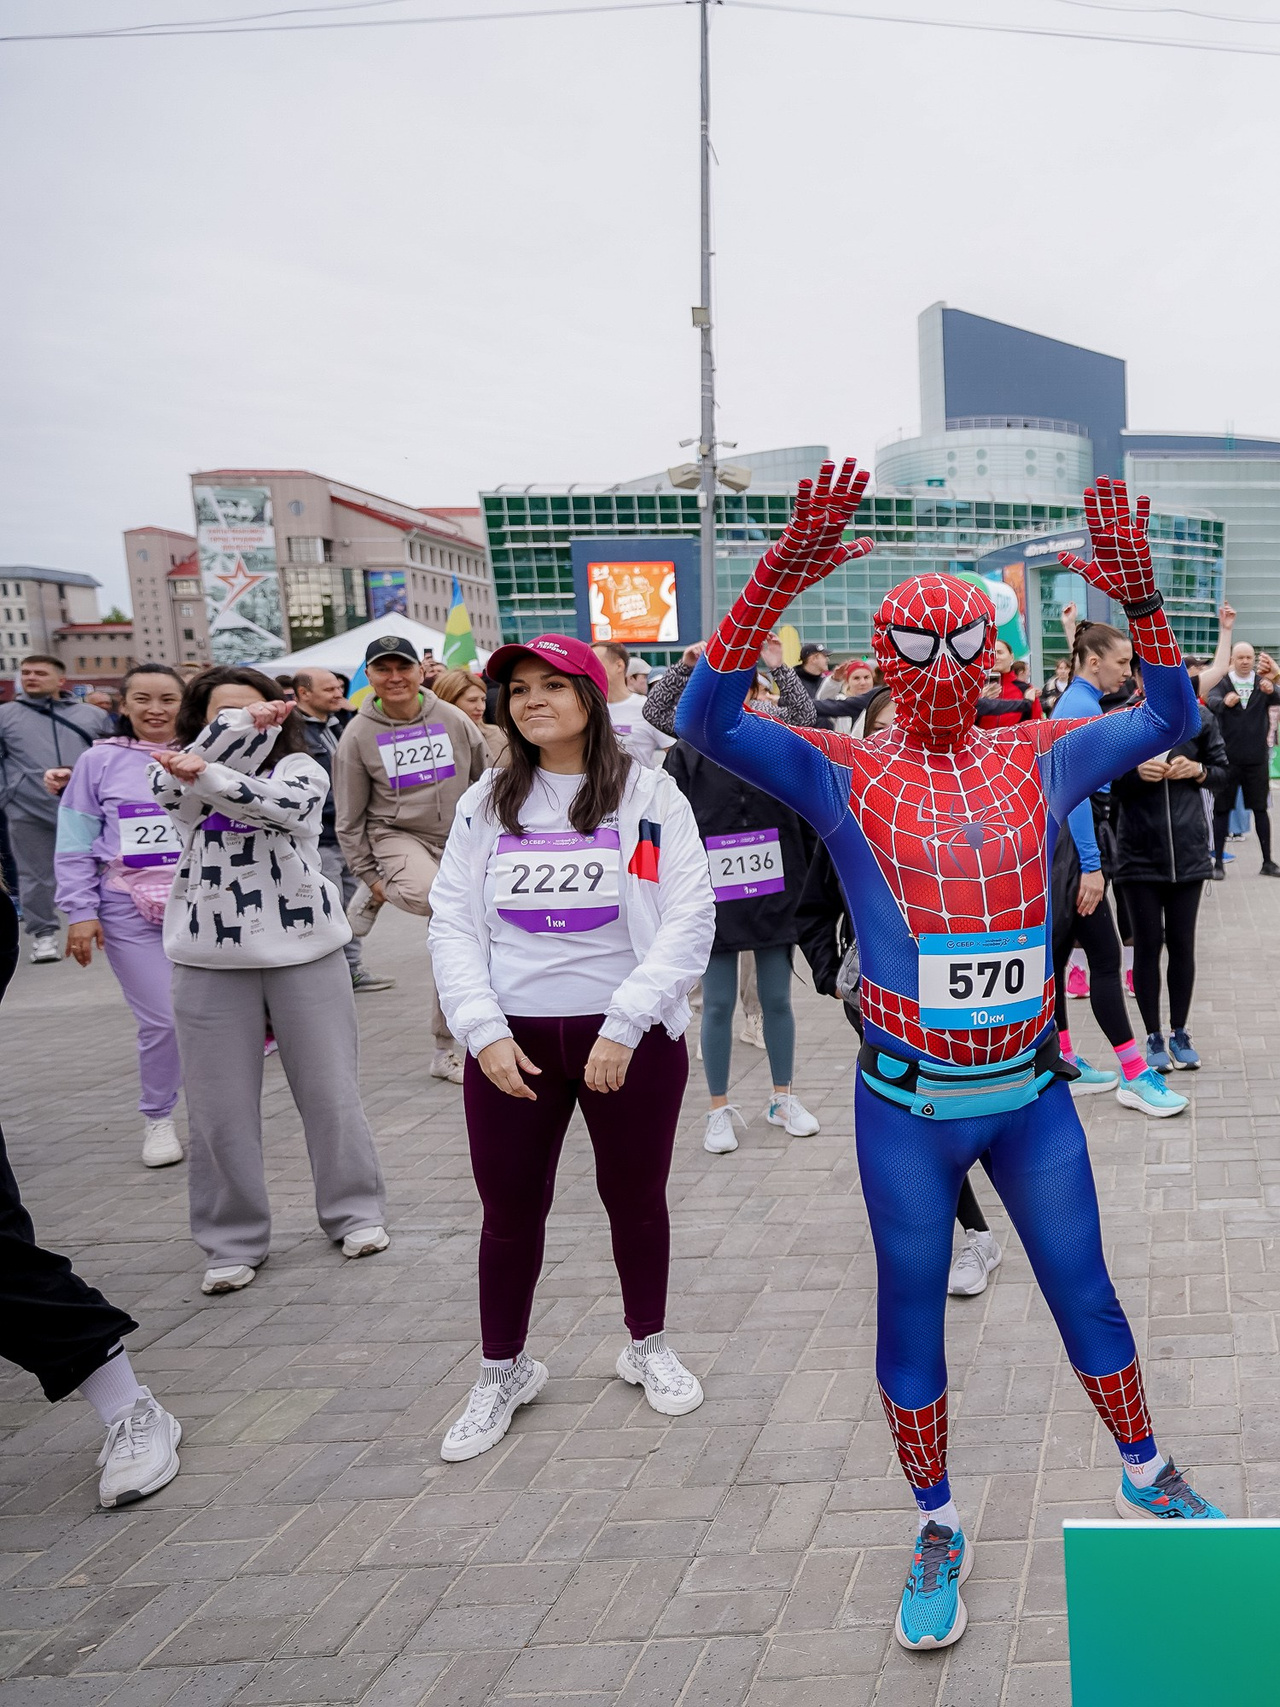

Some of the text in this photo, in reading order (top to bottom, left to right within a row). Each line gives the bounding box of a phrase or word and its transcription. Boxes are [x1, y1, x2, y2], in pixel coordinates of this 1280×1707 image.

[393, 743, 447, 767] 2222
[511, 861, 605, 895] 2229
[720, 852, 774, 876] 2136
[948, 958, 1025, 1000] 570
